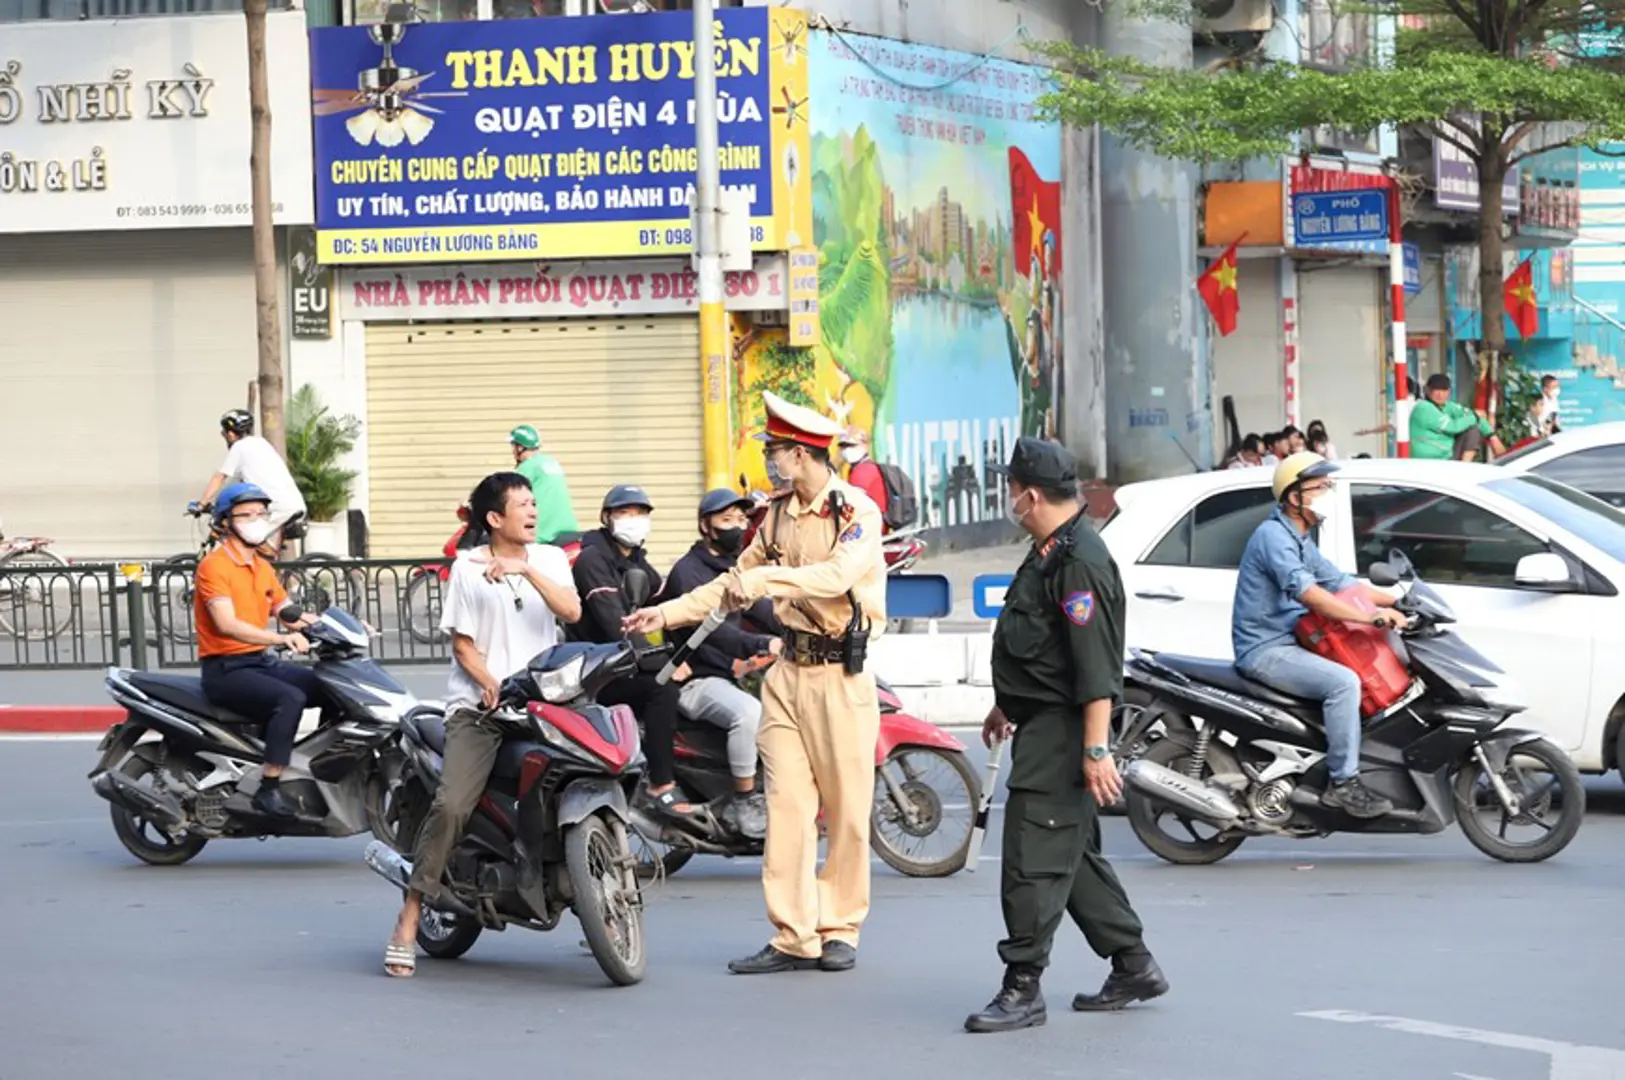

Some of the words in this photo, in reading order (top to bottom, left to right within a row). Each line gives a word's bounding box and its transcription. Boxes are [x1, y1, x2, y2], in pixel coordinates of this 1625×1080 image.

[445, 46, 598, 88] THANH
[37, 69, 133, 124] NHĨ
[147, 63, 214, 119] KỲ
[474, 105, 564, 138] QUẠT
[572, 95, 647, 135] ĐIỆN
[656, 100, 678, 126] 4
[46, 160, 66, 192] &
[331, 154, 403, 184] CHUYÊN
[407, 156, 458, 182] CUNG
[462, 147, 499, 179] CẤP
[505, 153, 552, 182] QUẠT
[556, 147, 600, 181] ĐIỆN
[605, 145, 643, 175] CÁC
[648, 144, 697, 173] CÔNG
[717, 141, 761, 170] RÌNH
[337, 197, 364, 217] UY
[369, 192, 410, 218] TÍN,
[415, 188, 469, 215] CHẤT
[474, 190, 550, 216] LƯỢNG,
[555, 184, 599, 211] BẢO
[604, 185, 663, 208] HÀNH
[361, 237, 378, 253] 54
[294, 287, 327, 313] EU
[353, 271, 410, 307] NHÀ
[418, 271, 491, 305] PHÂN
[569, 274, 644, 308] QUẠT
[650, 265, 699, 305] ĐIỆ
[767, 273, 781, 296] 1
